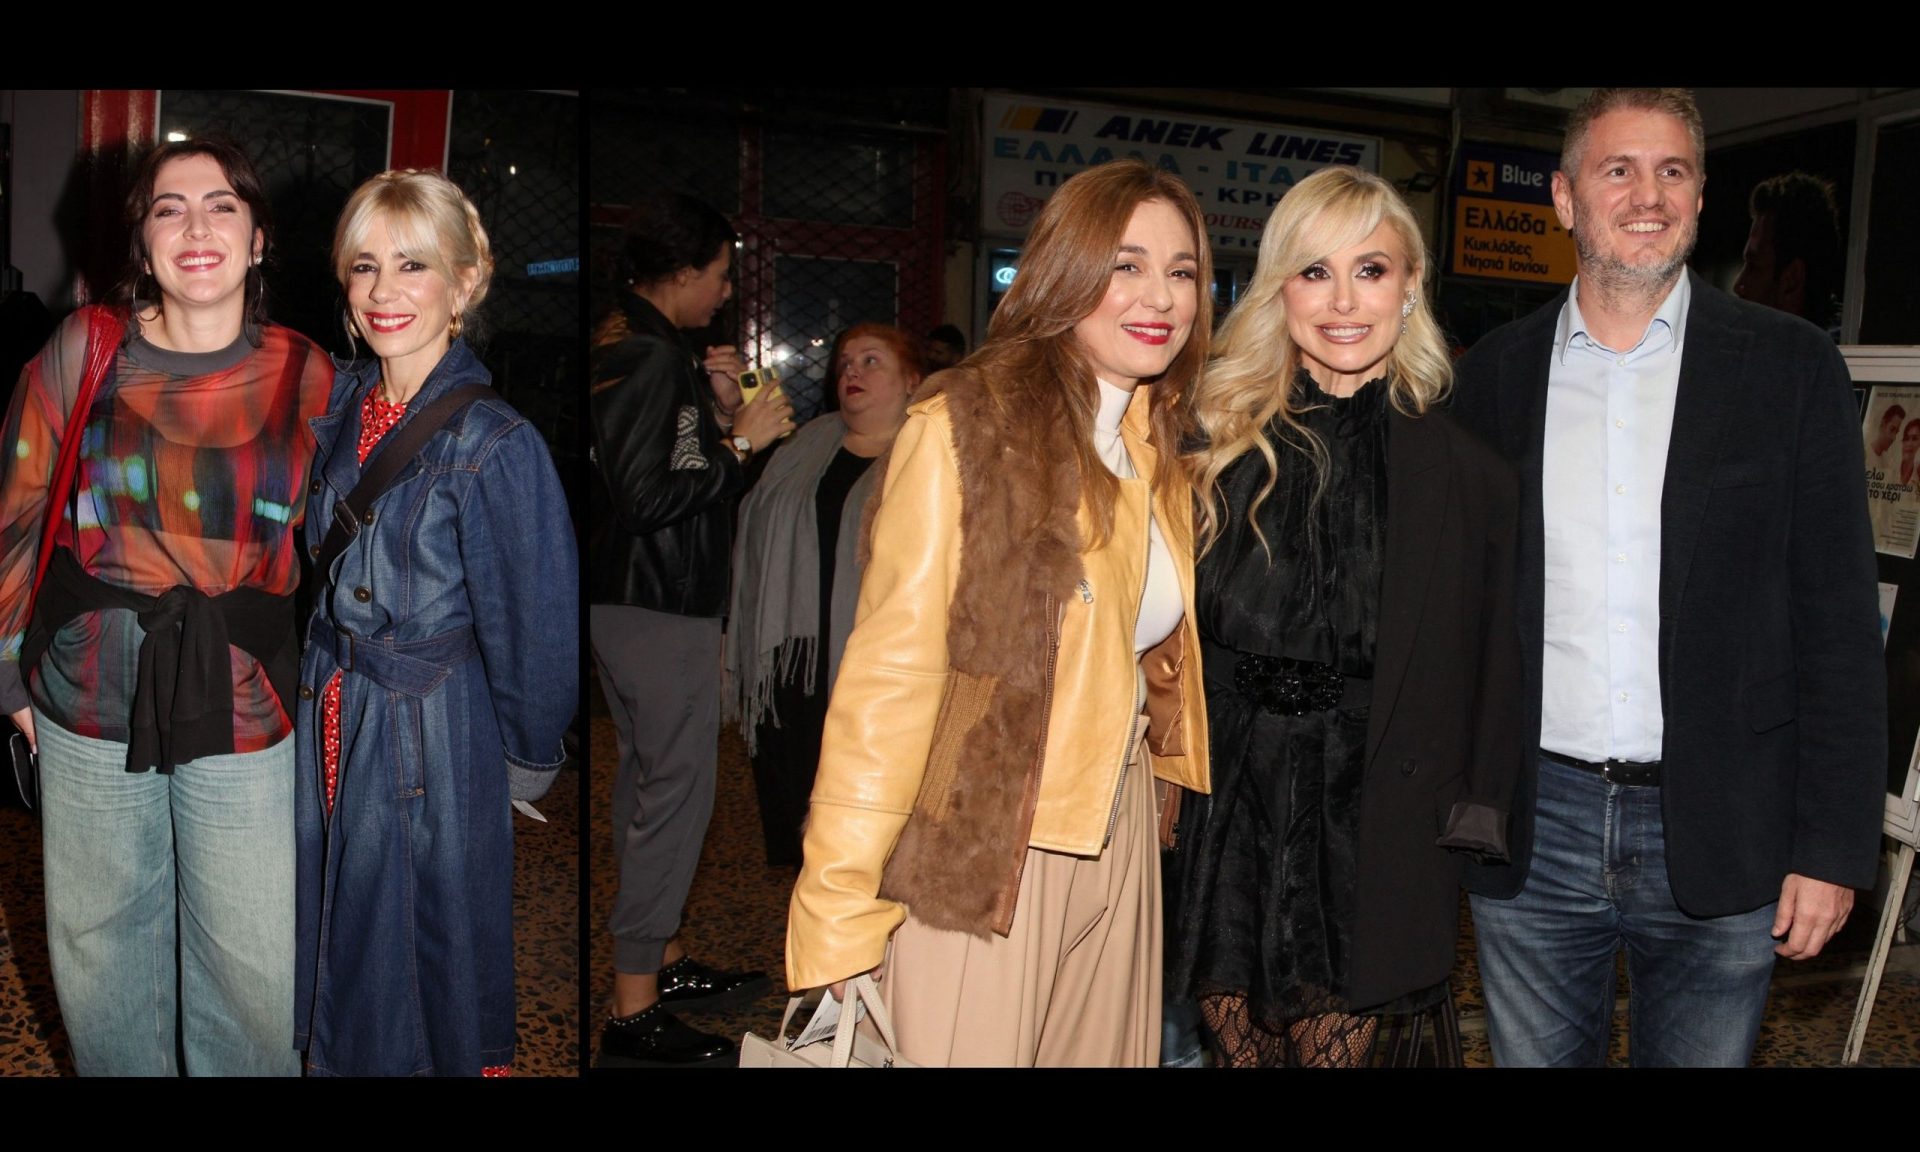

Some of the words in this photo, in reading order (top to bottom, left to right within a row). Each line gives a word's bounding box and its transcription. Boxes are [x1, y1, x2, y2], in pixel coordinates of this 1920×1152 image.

[1094, 115, 1232, 151] ANEK
[1246, 132, 1366, 166] LINES
[1226, 160, 1312, 187] ΙΤΑ
[1501, 164, 1544, 187] Blue
[1205, 213, 1264, 231] OURS
[1465, 206, 1546, 236] Ελλάδα
[1463, 235, 1532, 259] Κυκλάδες
[1462, 254, 1504, 272] Νησιά
[1509, 258, 1549, 275] Ιονίου
